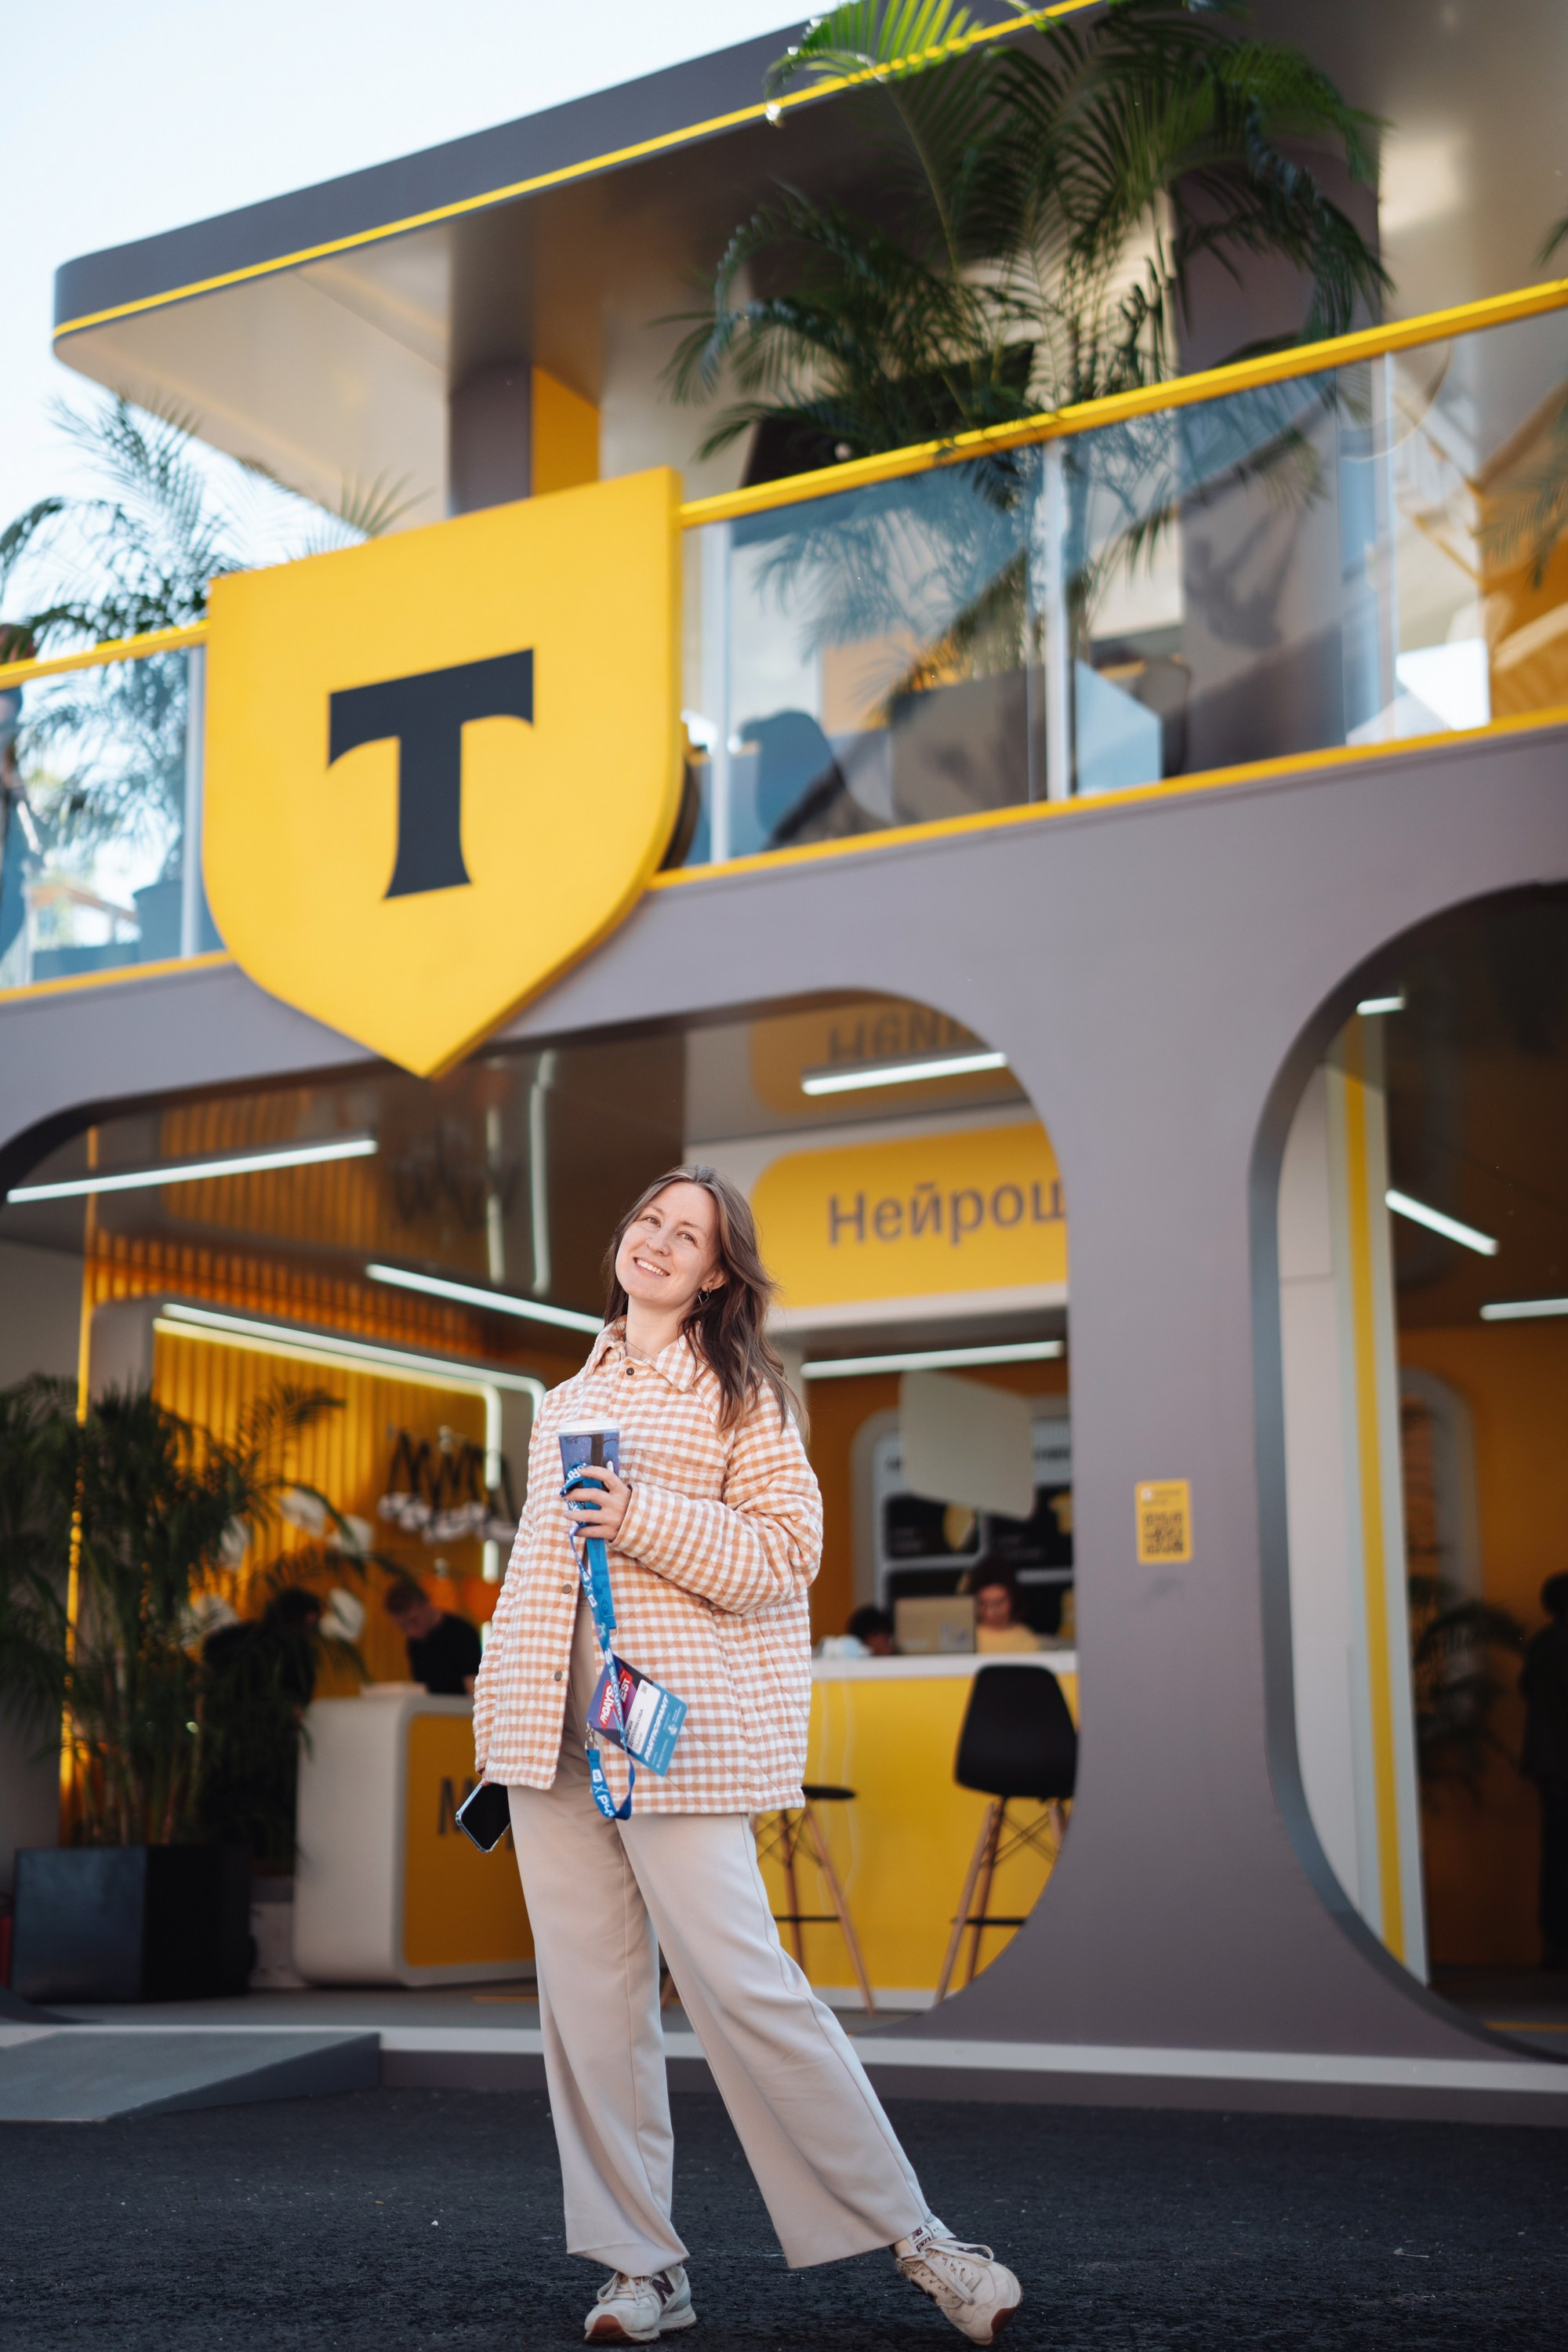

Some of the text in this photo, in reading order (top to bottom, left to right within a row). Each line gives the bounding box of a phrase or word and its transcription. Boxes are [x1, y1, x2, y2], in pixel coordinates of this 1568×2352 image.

[327, 647, 535, 901] T
[620, 1678, 630, 1702] EST
[644, 1693, 670, 1762] PARTICIPANT
[652, 2270, 675, 2306] N
